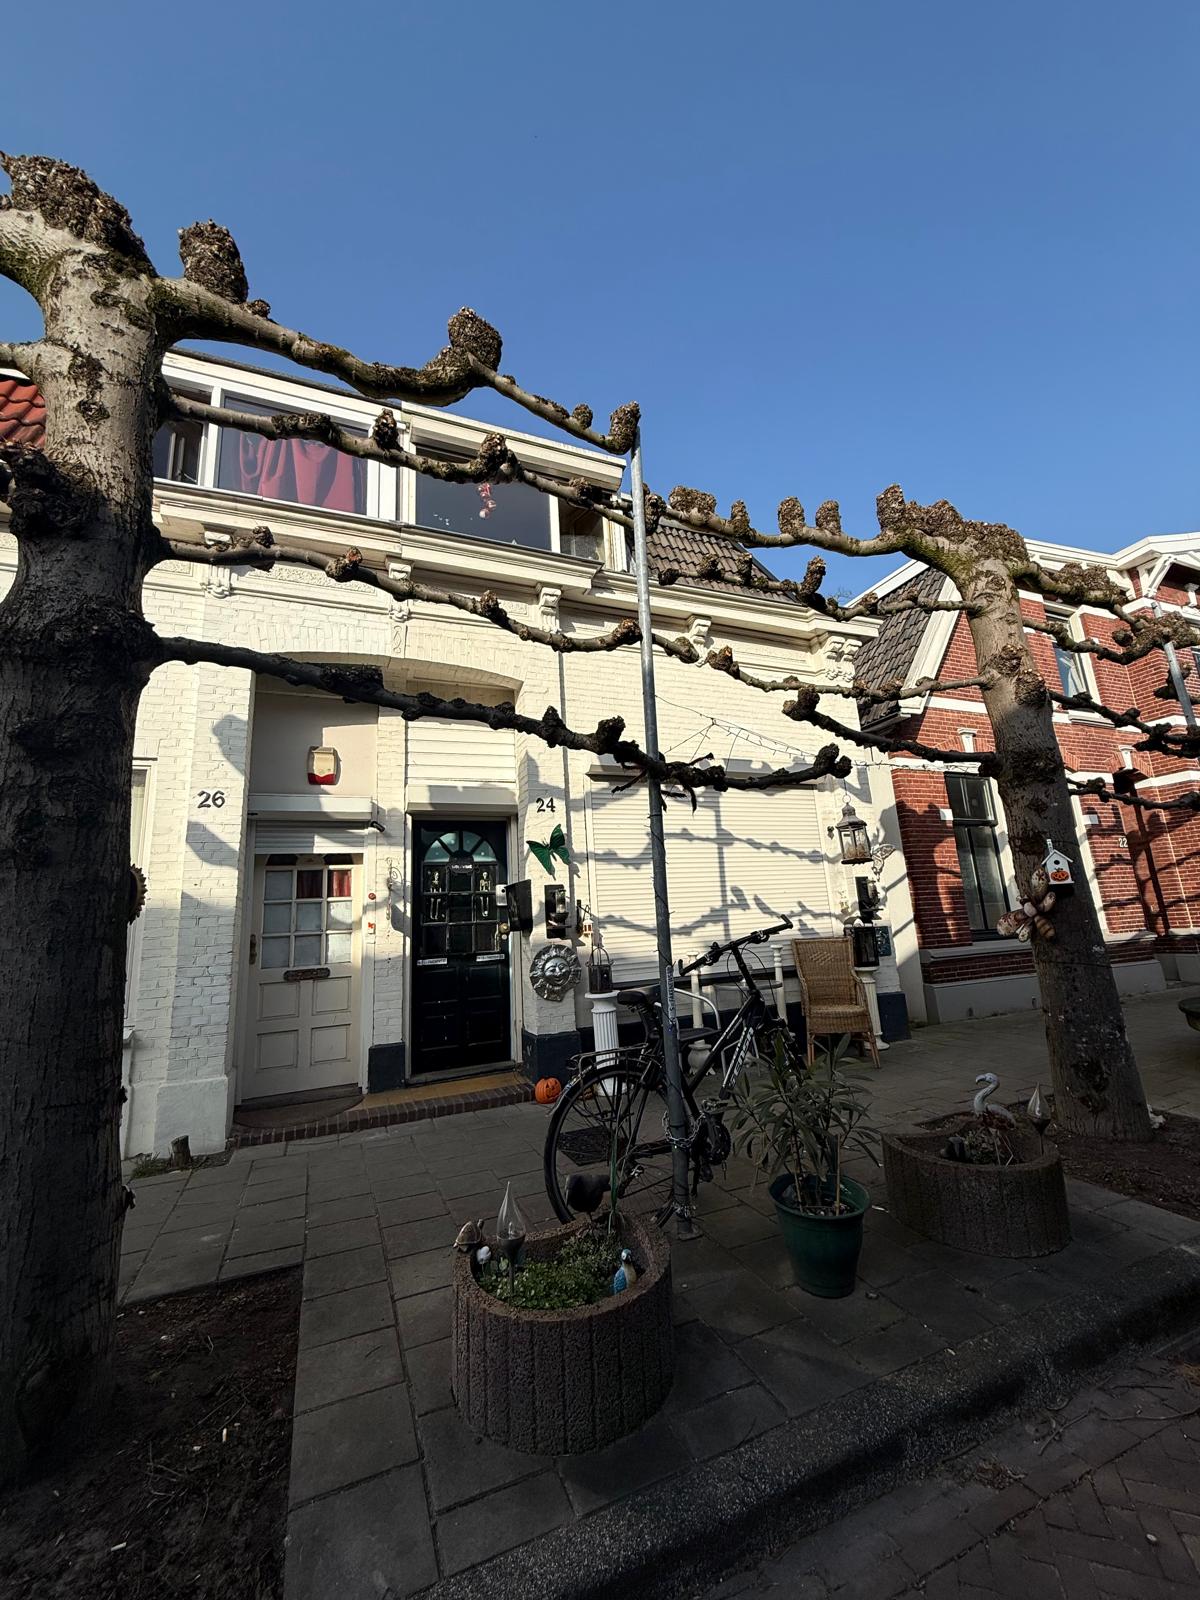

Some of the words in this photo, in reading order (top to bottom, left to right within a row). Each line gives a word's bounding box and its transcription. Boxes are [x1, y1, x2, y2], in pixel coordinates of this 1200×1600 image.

[197, 790, 226, 809] 26
[535, 797, 556, 813] 24
[1118, 837, 1129, 848] 22
